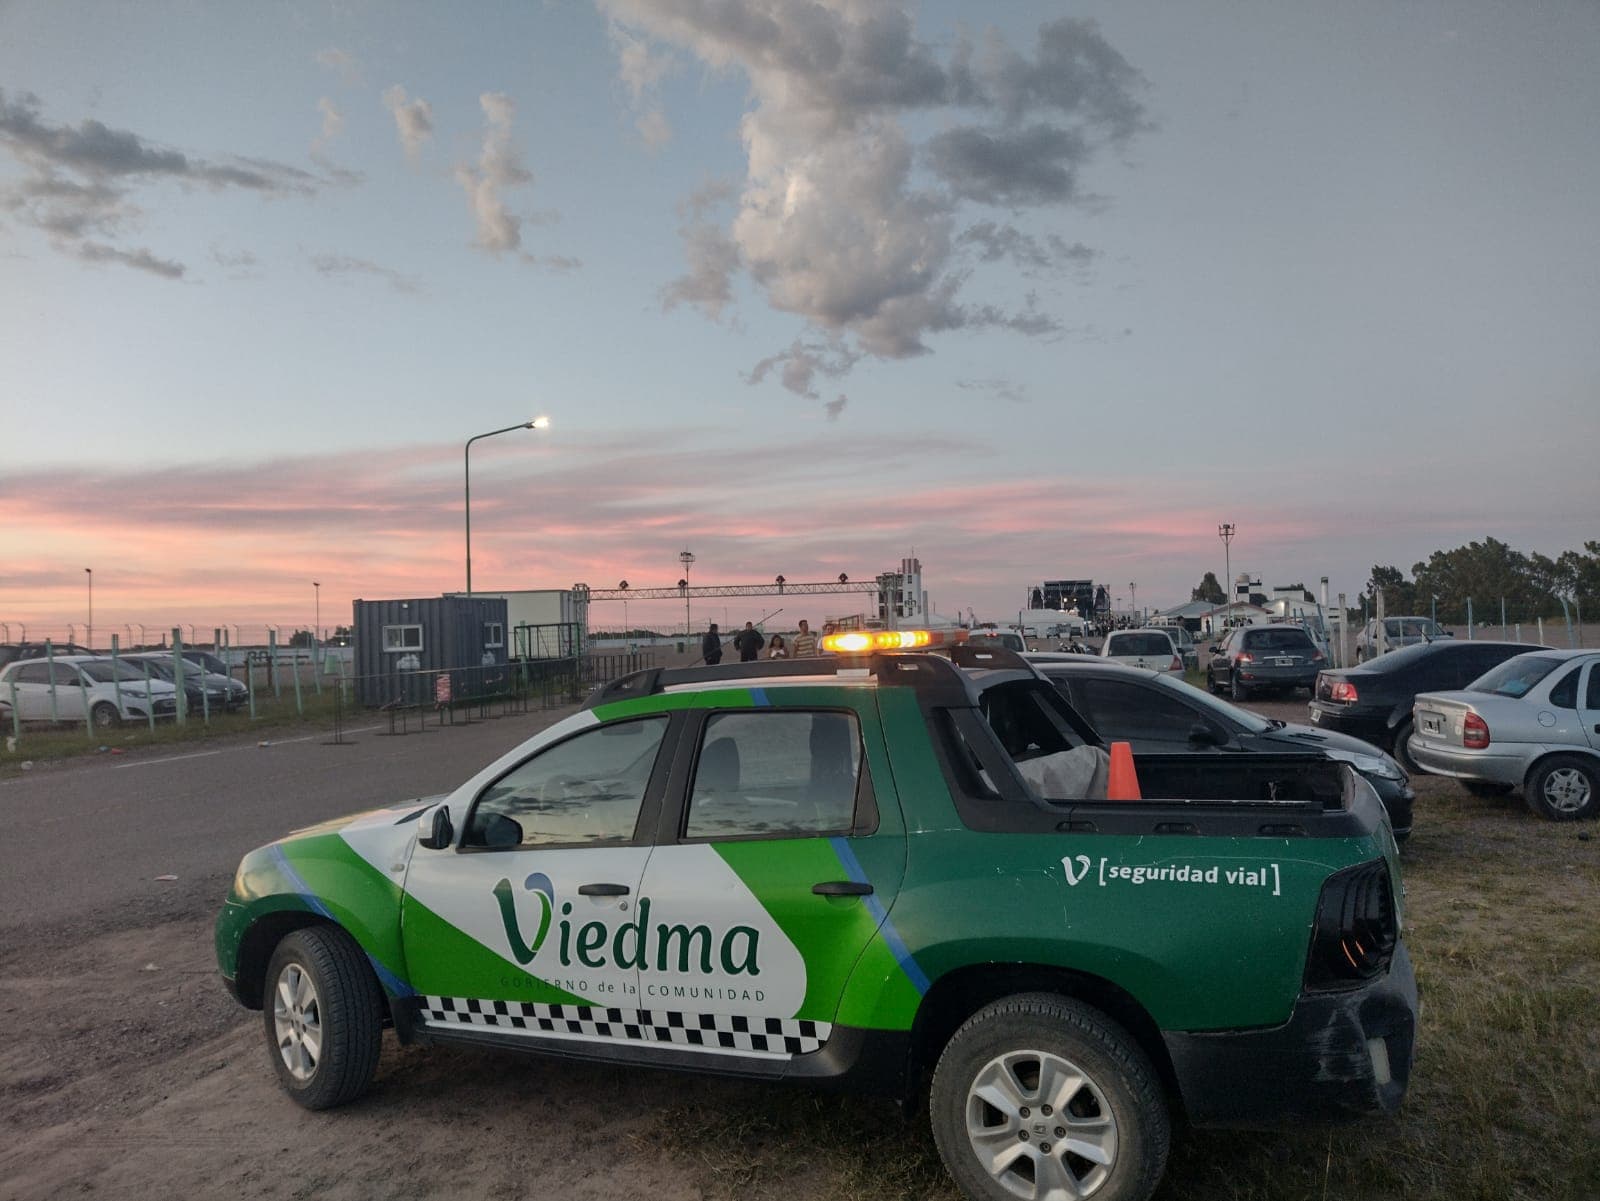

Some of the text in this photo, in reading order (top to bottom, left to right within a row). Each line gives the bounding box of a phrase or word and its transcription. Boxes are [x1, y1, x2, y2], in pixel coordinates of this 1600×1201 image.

[492, 872, 761, 976] Viedma
[500, 976, 765, 1002] GOBIERNO de la COMUNIDAD
